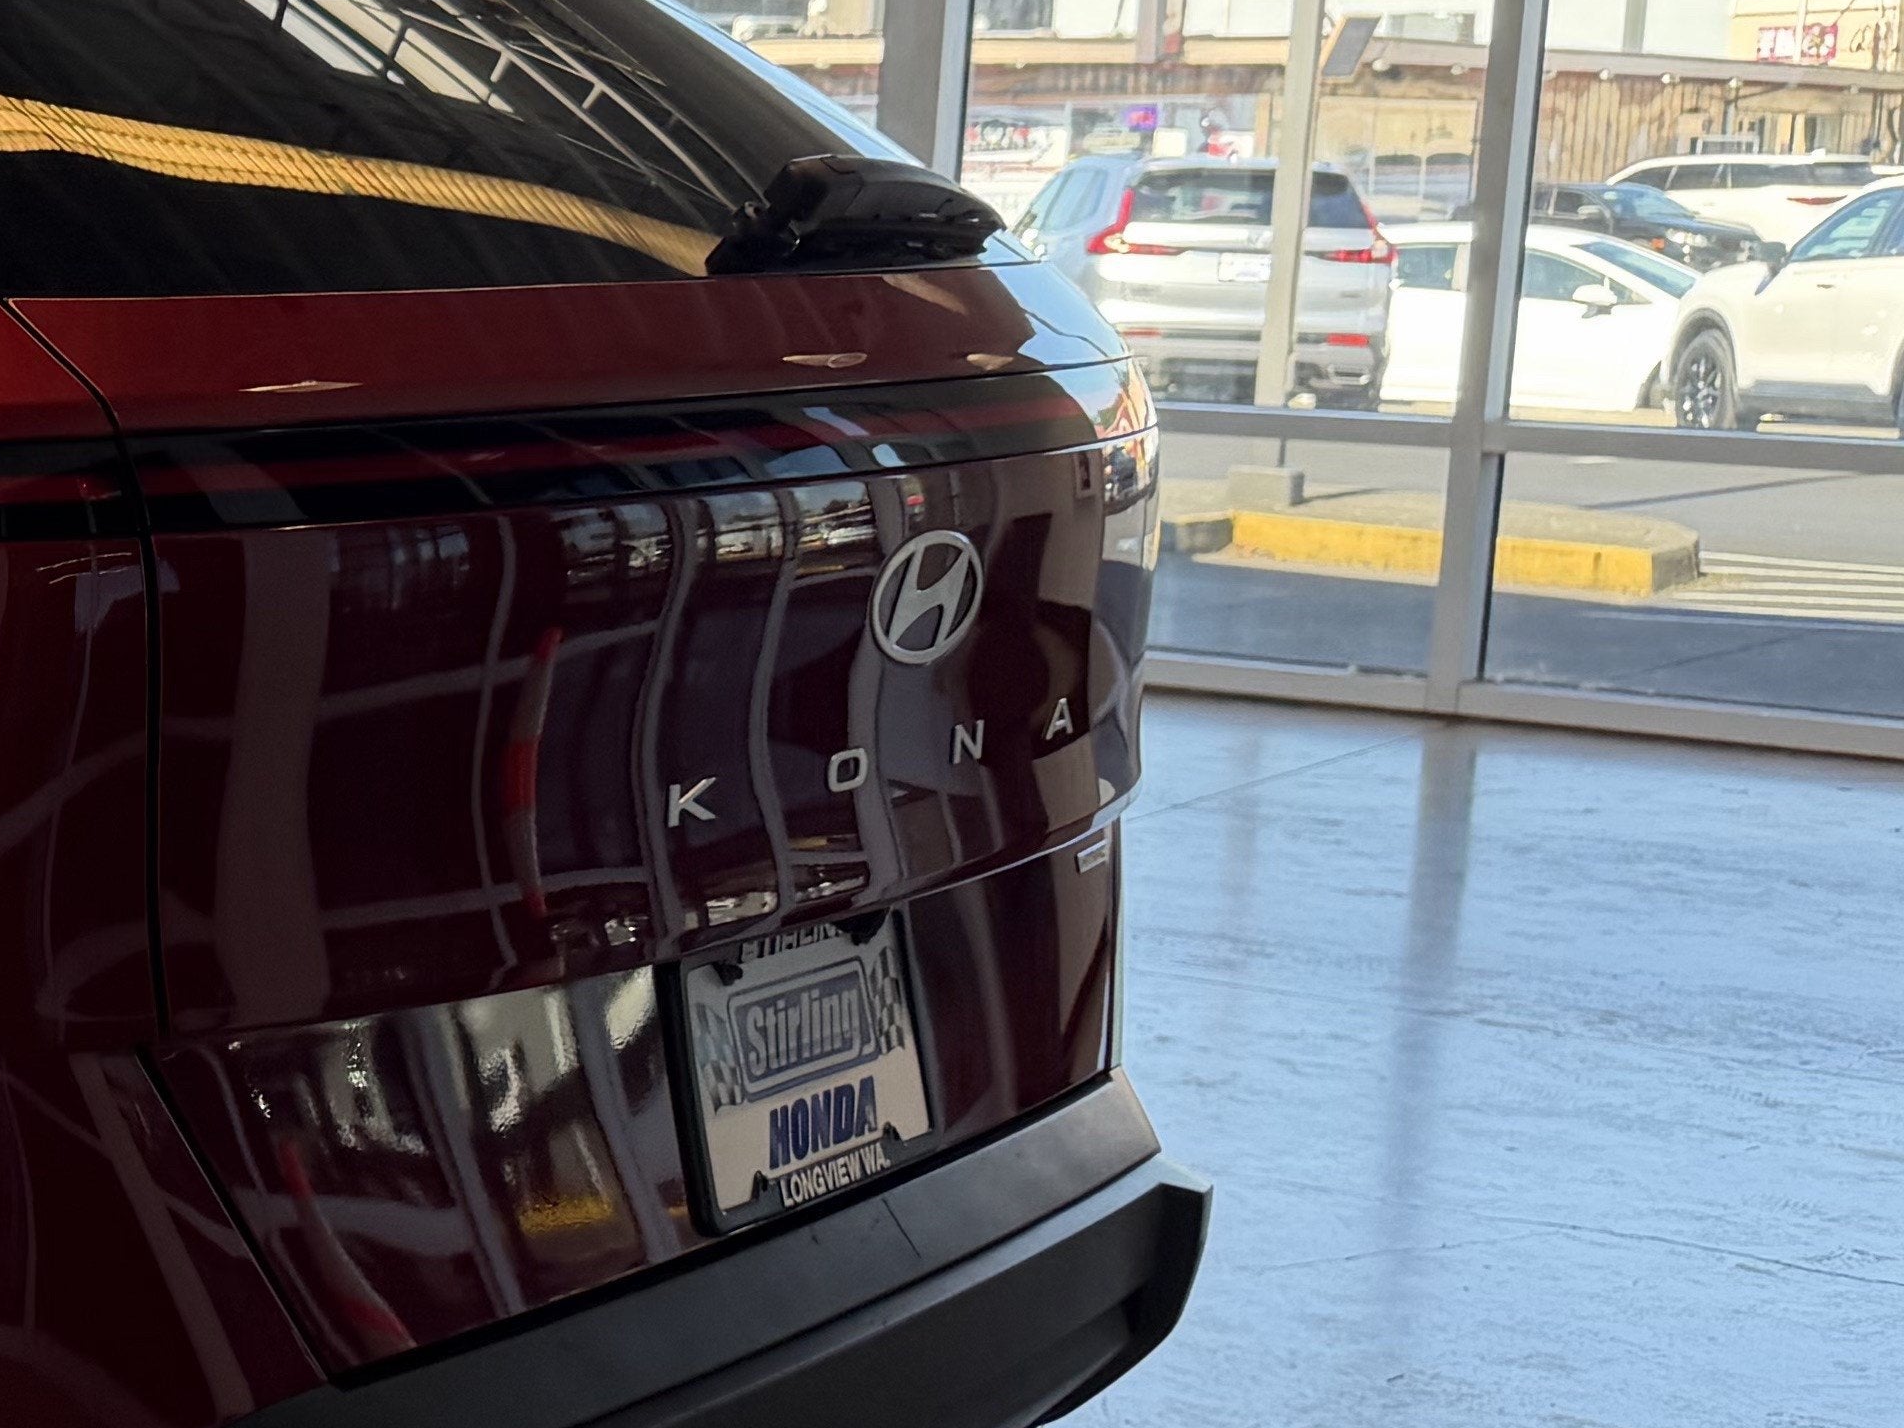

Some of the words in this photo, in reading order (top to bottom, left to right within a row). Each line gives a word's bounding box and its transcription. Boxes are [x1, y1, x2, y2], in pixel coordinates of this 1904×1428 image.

[667, 695, 1072, 828] KONA
[746, 987, 862, 1077] Stirling
[769, 1075, 879, 1171] HONDA
[779, 1151, 863, 1208] LONGVIEW
